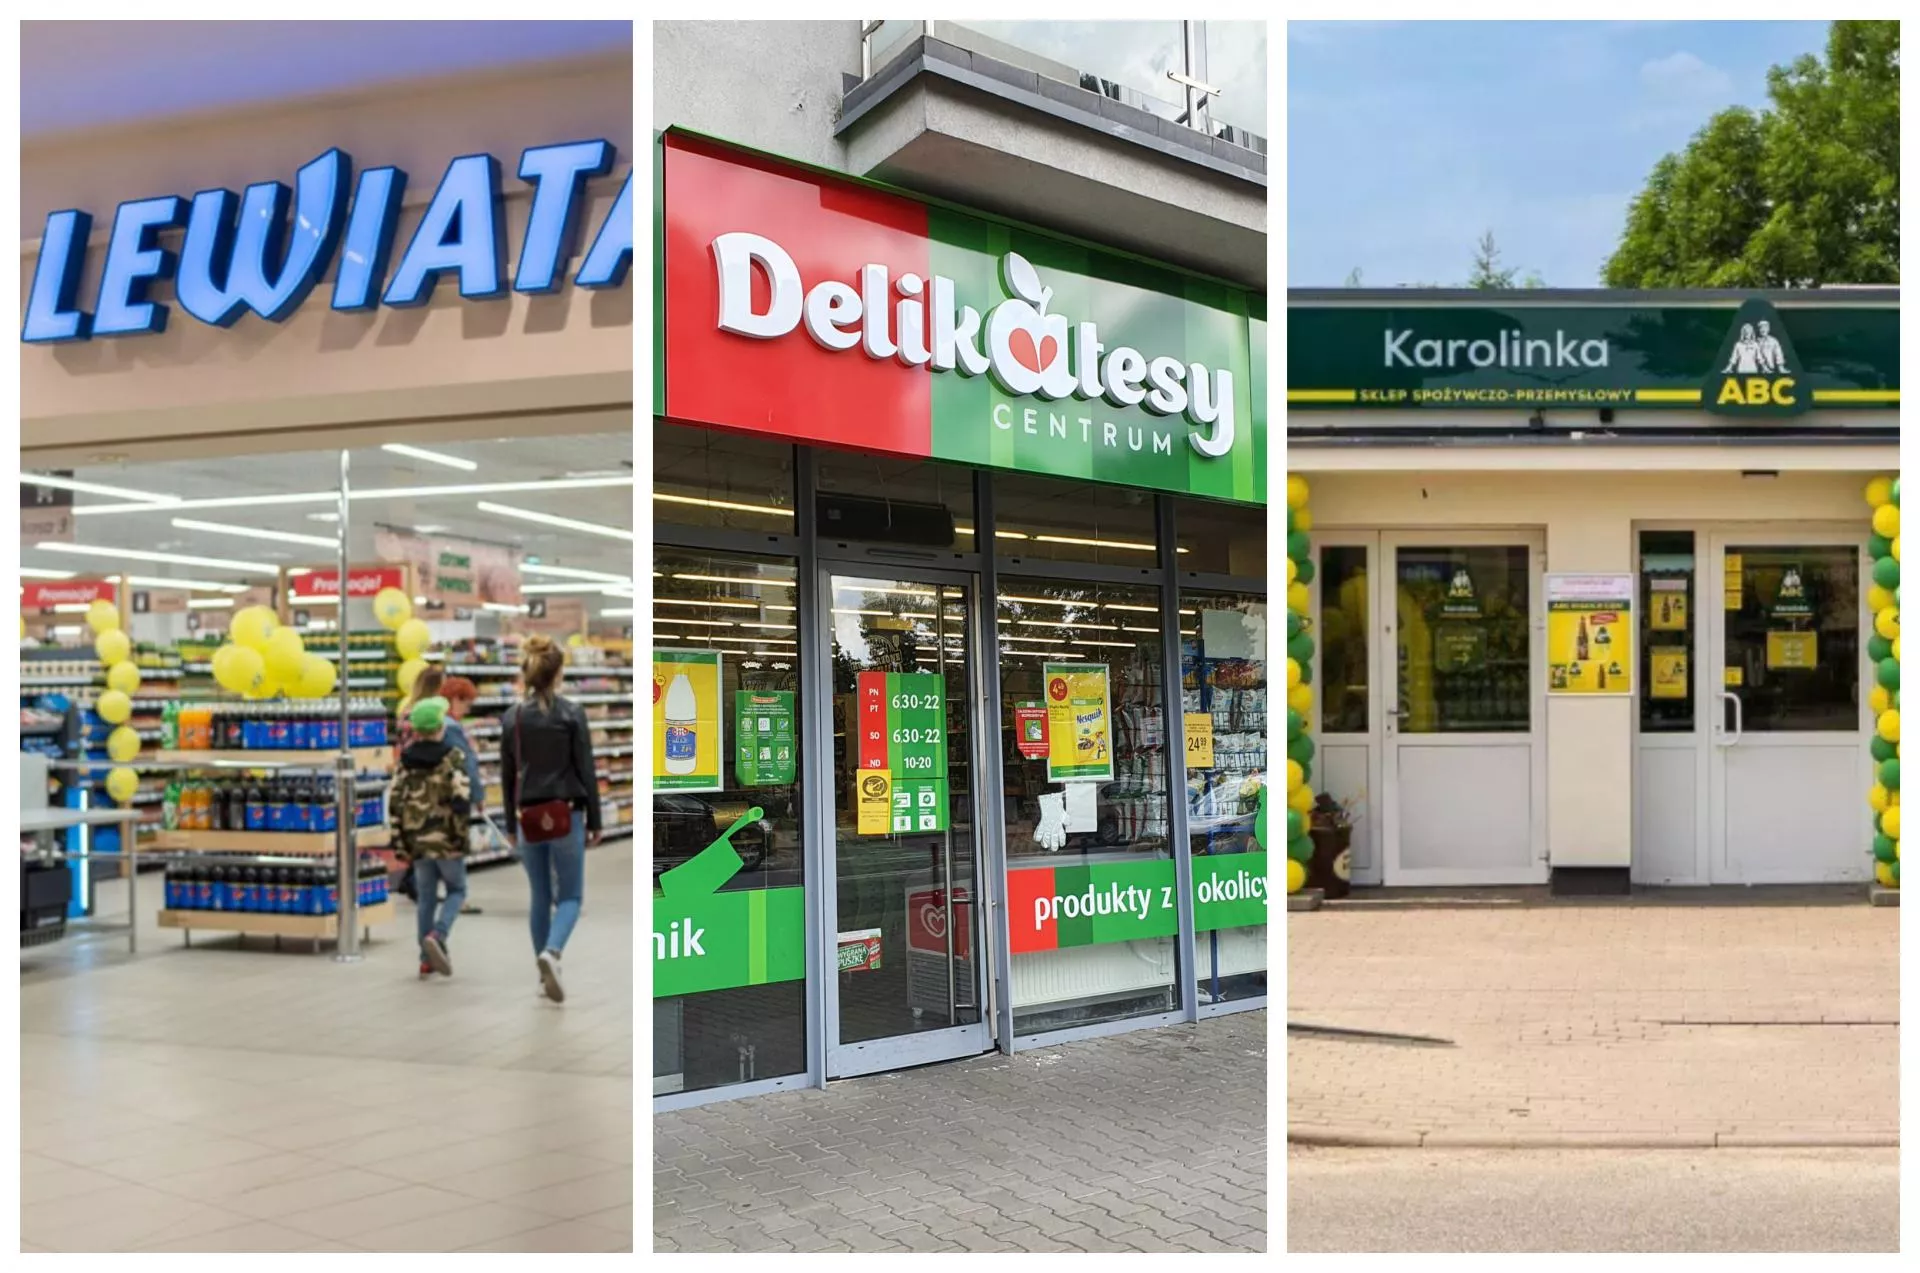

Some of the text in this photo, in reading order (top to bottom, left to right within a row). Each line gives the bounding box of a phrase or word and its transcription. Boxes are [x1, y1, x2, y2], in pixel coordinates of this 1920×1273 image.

[710, 231, 1236, 459] Delikatesy
[1383, 329, 1609, 369] Karolinka
[1359, 388, 1407, 401] SKLEP
[1716, 377, 1797, 406] ABC
[992, 403, 1172, 457] CENTRUM
[869, 688, 879, 696] PN
[869, 704, 878, 713] PT
[1076, 707, 1103, 724] Nesquik
[869, 731, 880, 740] SO
[1188, 736, 1200, 752] 24
[869, 759, 881, 768] ND
[903, 756, 932, 769] 10-20
[1034, 881, 1152, 931] produkty
[1160, 886, 1173, 909] z
